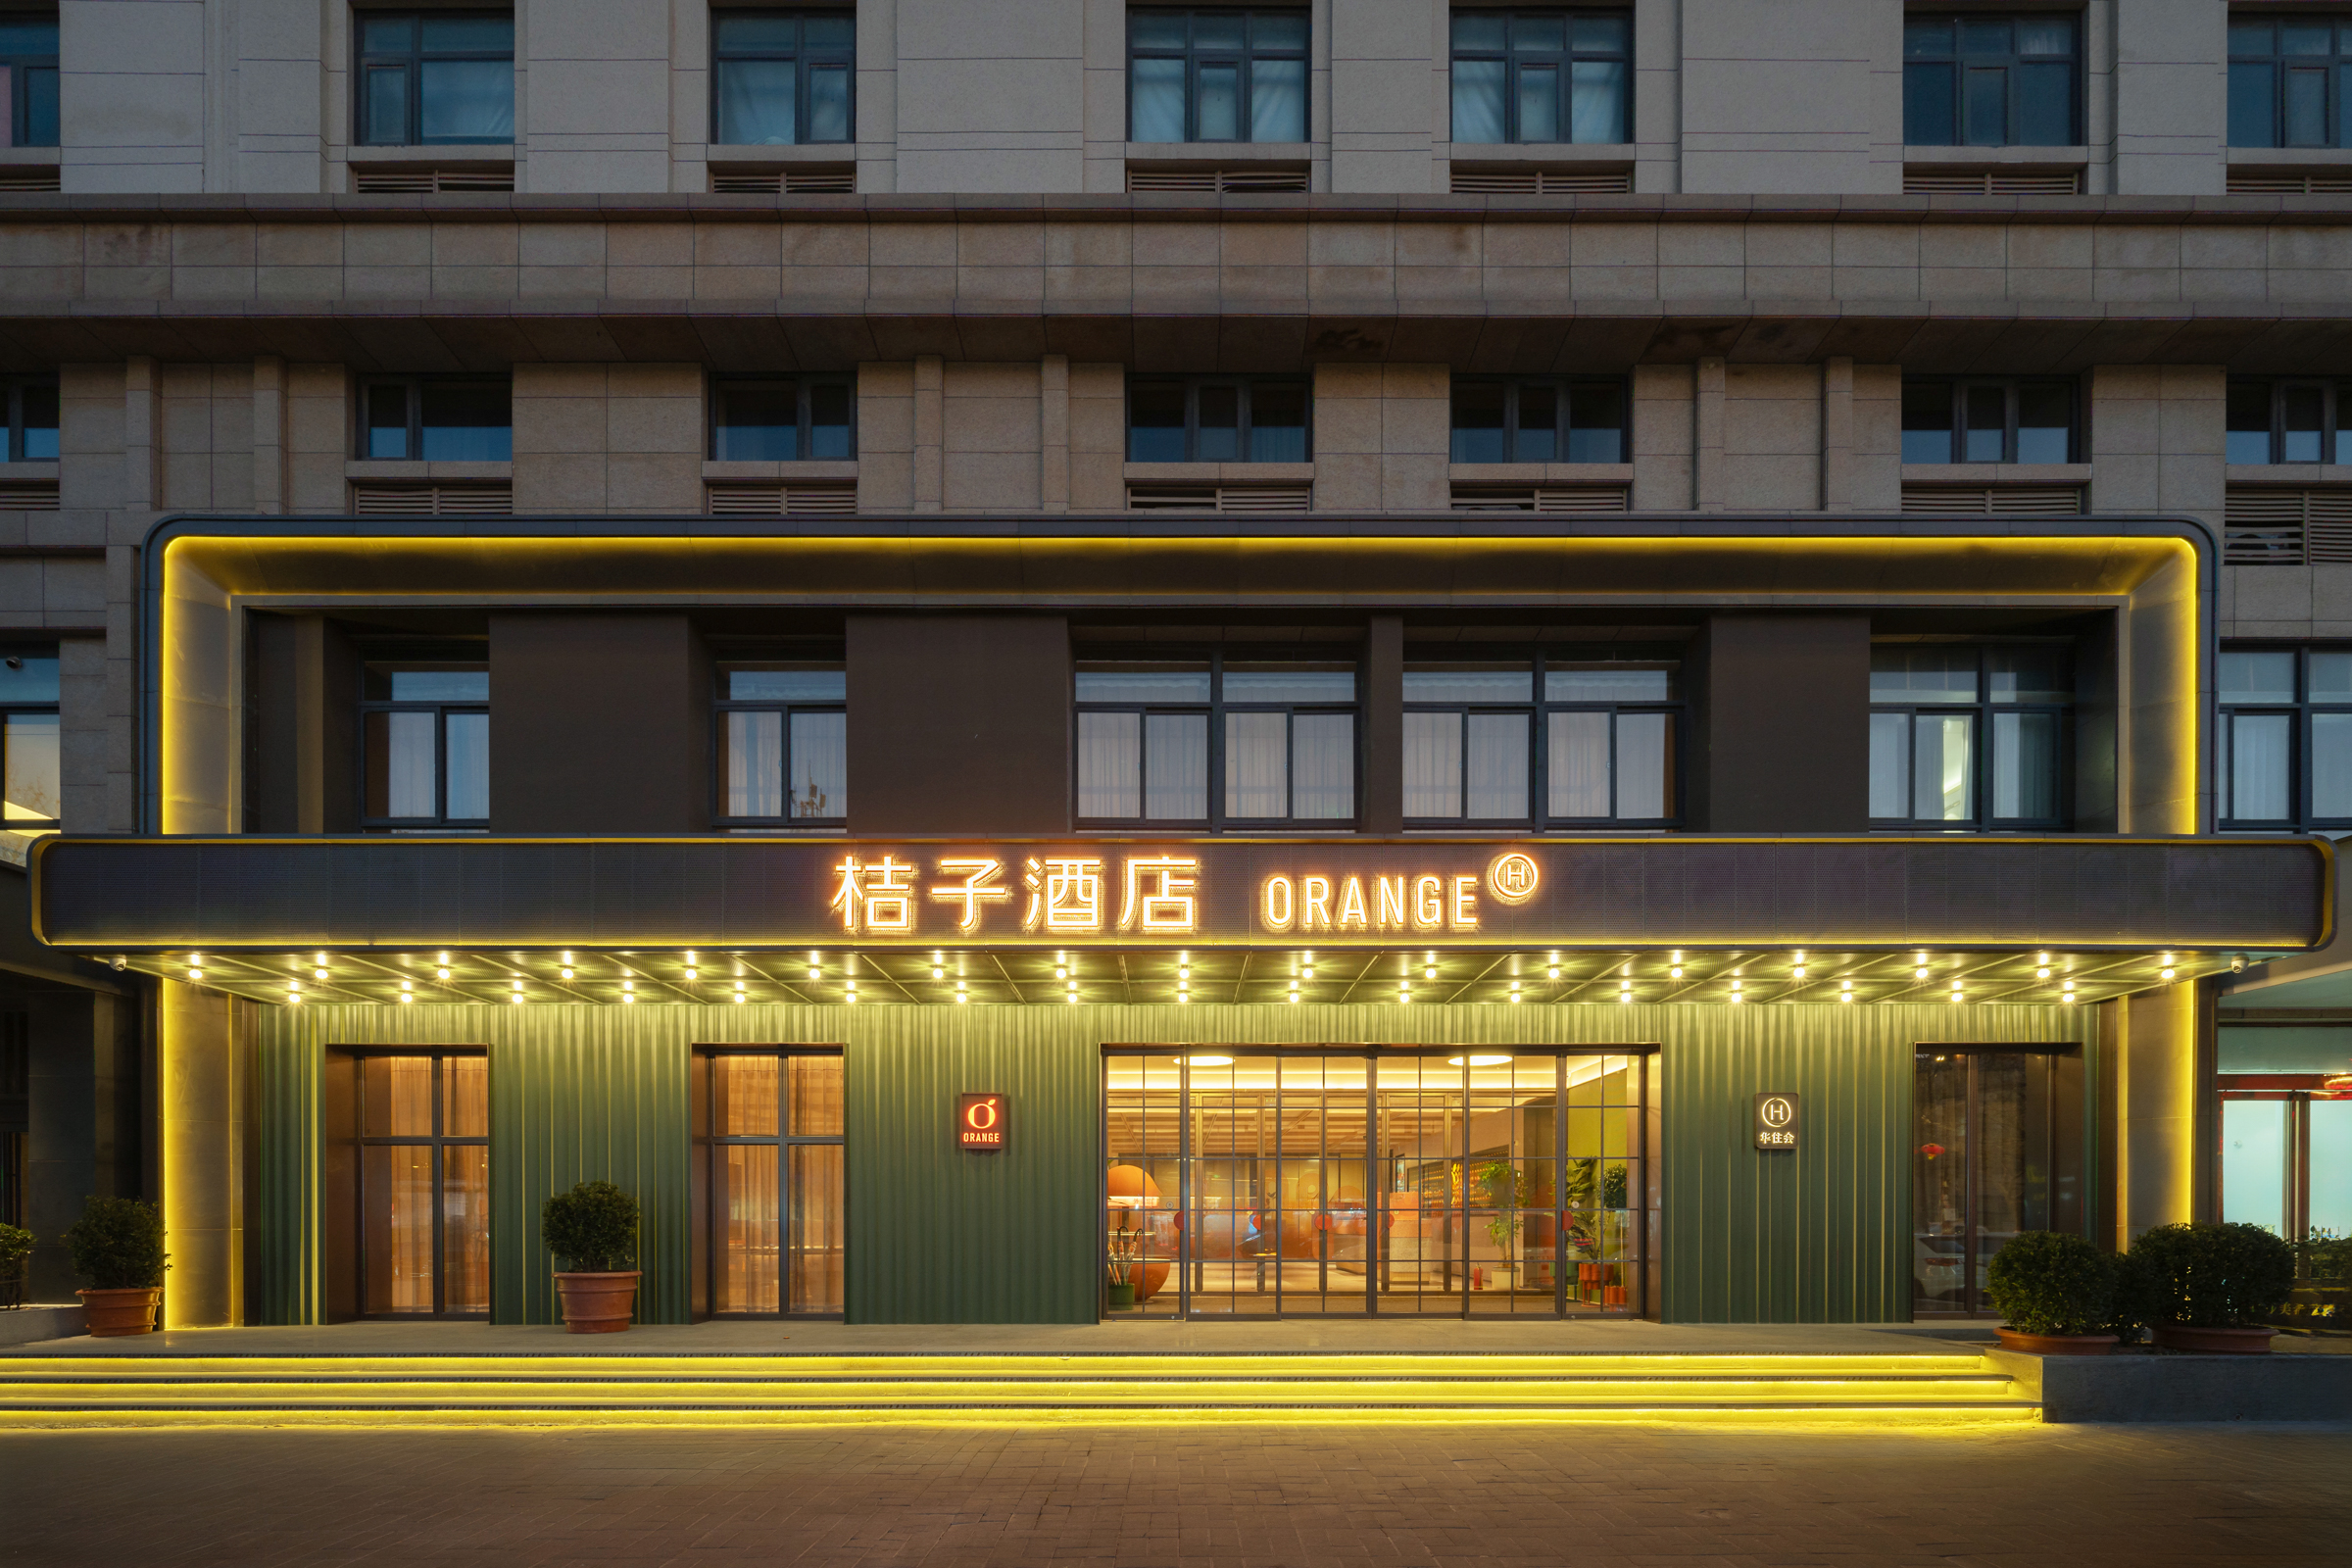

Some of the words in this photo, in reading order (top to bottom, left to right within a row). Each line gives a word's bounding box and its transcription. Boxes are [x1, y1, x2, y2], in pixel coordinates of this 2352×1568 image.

[832, 856, 1198, 929] 桔子酒店
[1266, 875, 1479, 926] ORANGE
[962, 1132, 1000, 1143] ORANGE
[1759, 1131, 1795, 1145] 华住会
